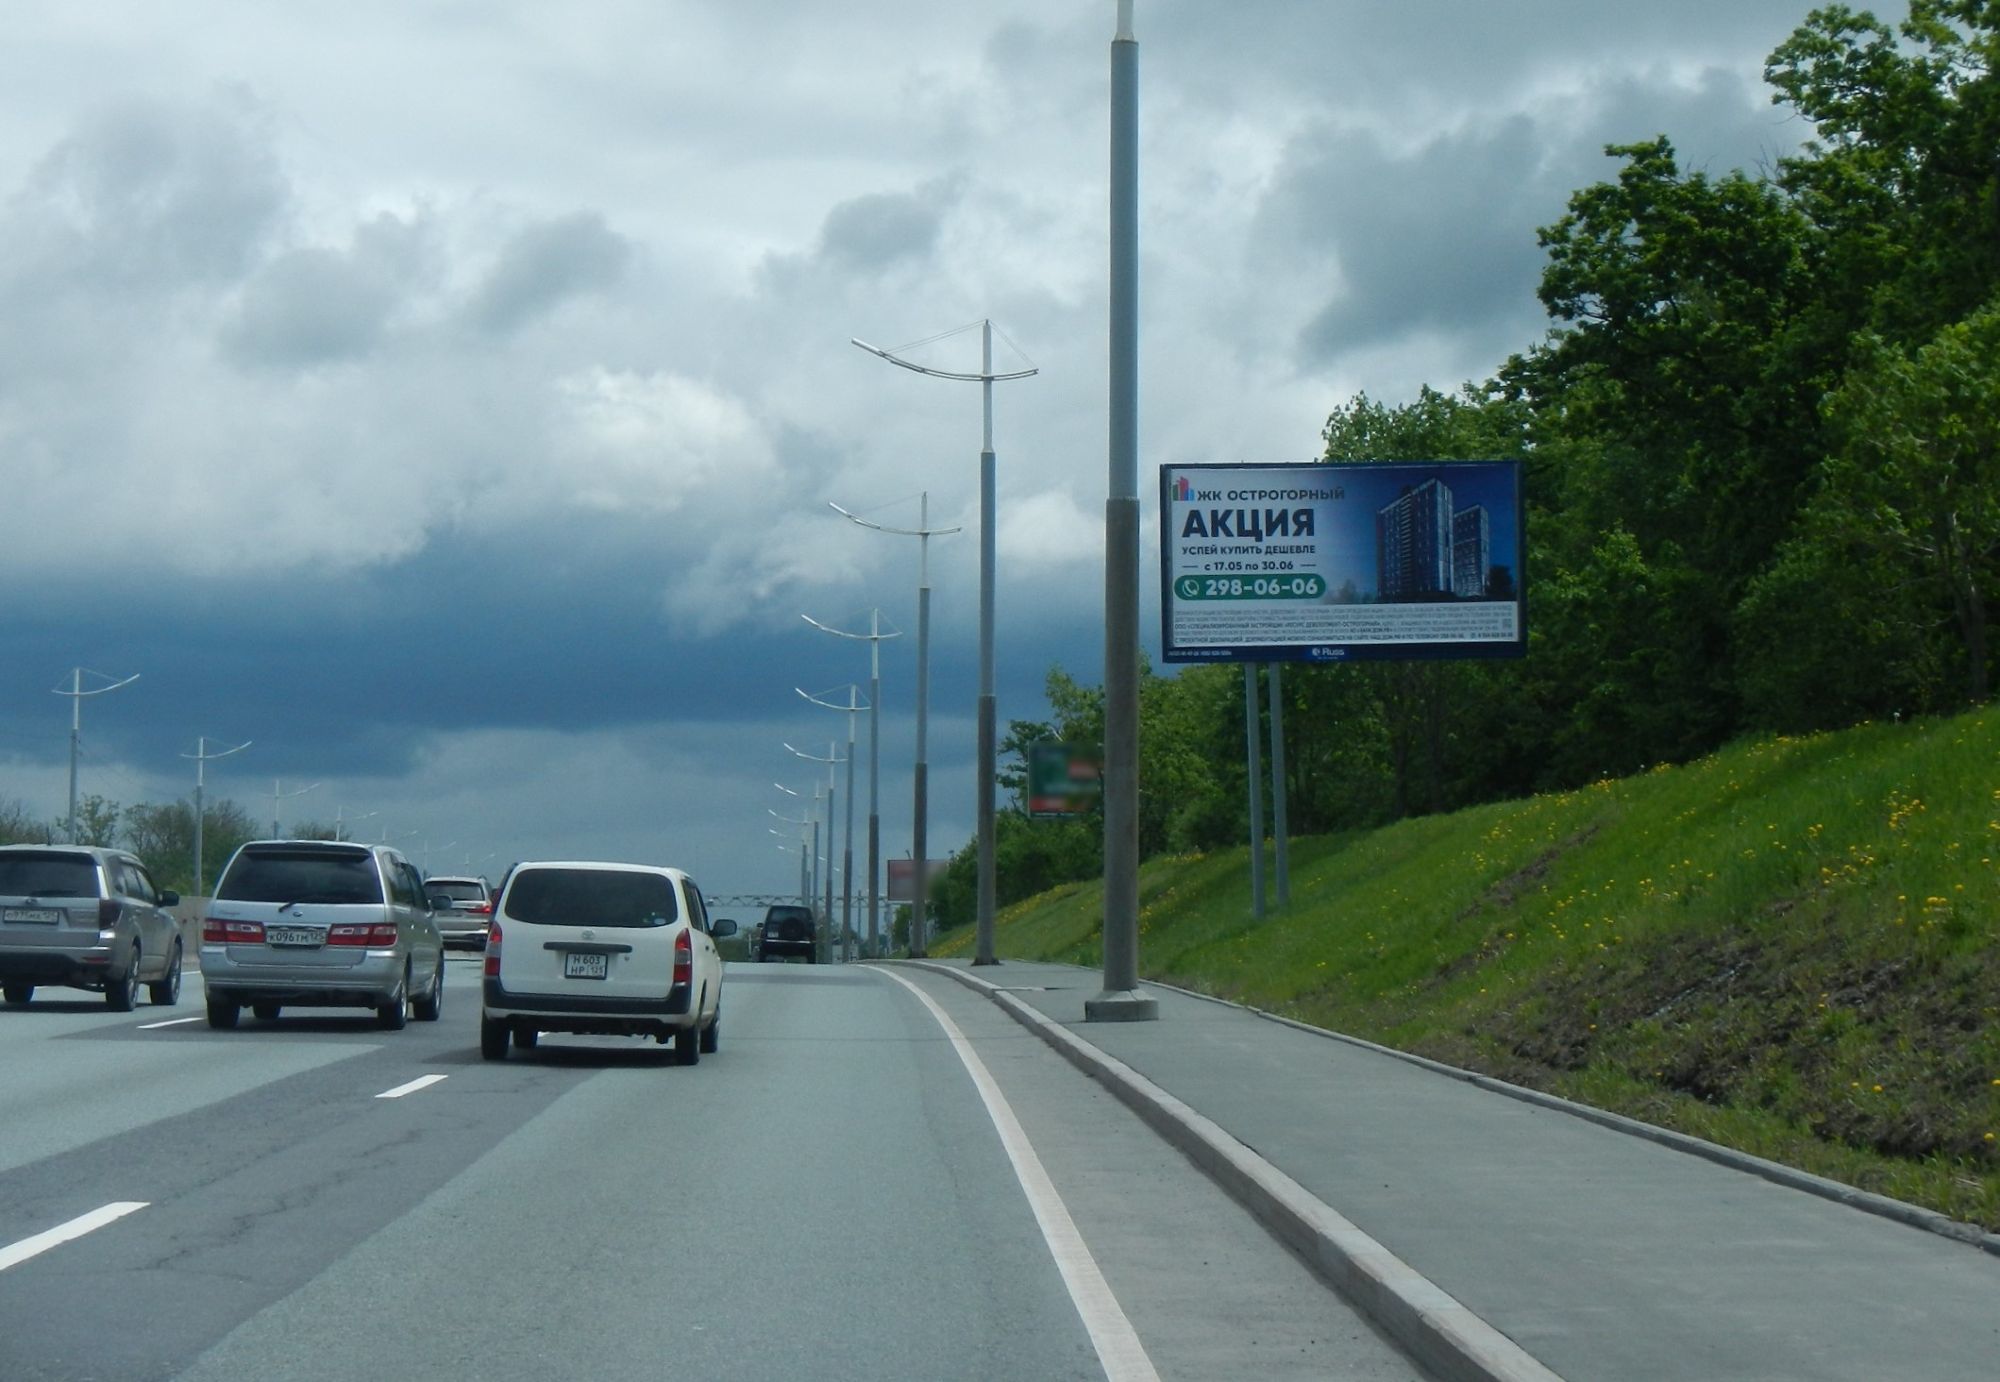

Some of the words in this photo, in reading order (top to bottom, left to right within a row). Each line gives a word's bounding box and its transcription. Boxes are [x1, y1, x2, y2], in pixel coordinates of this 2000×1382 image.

[1197, 490, 1222, 501] ЖК
[1227, 486, 1345, 502] ОСТРОГОРНЫЙ
[1182, 508, 1315, 542] АКЦИЯ
[1182, 545, 1217, 556] УСПЕЙ
[1221, 545, 1263, 555] КУПИТЬ
[1265, 544, 1316, 555] ДЕШЕВЛЕ
[1204, 563, 1211, 571] с
[1214, 561, 1242, 571] 17.05
[1262, 560, 1294, 570] 30.06
[1205, 579, 1317, 595] 298-06-06
[1322, 647, 1345, 656] Russ
